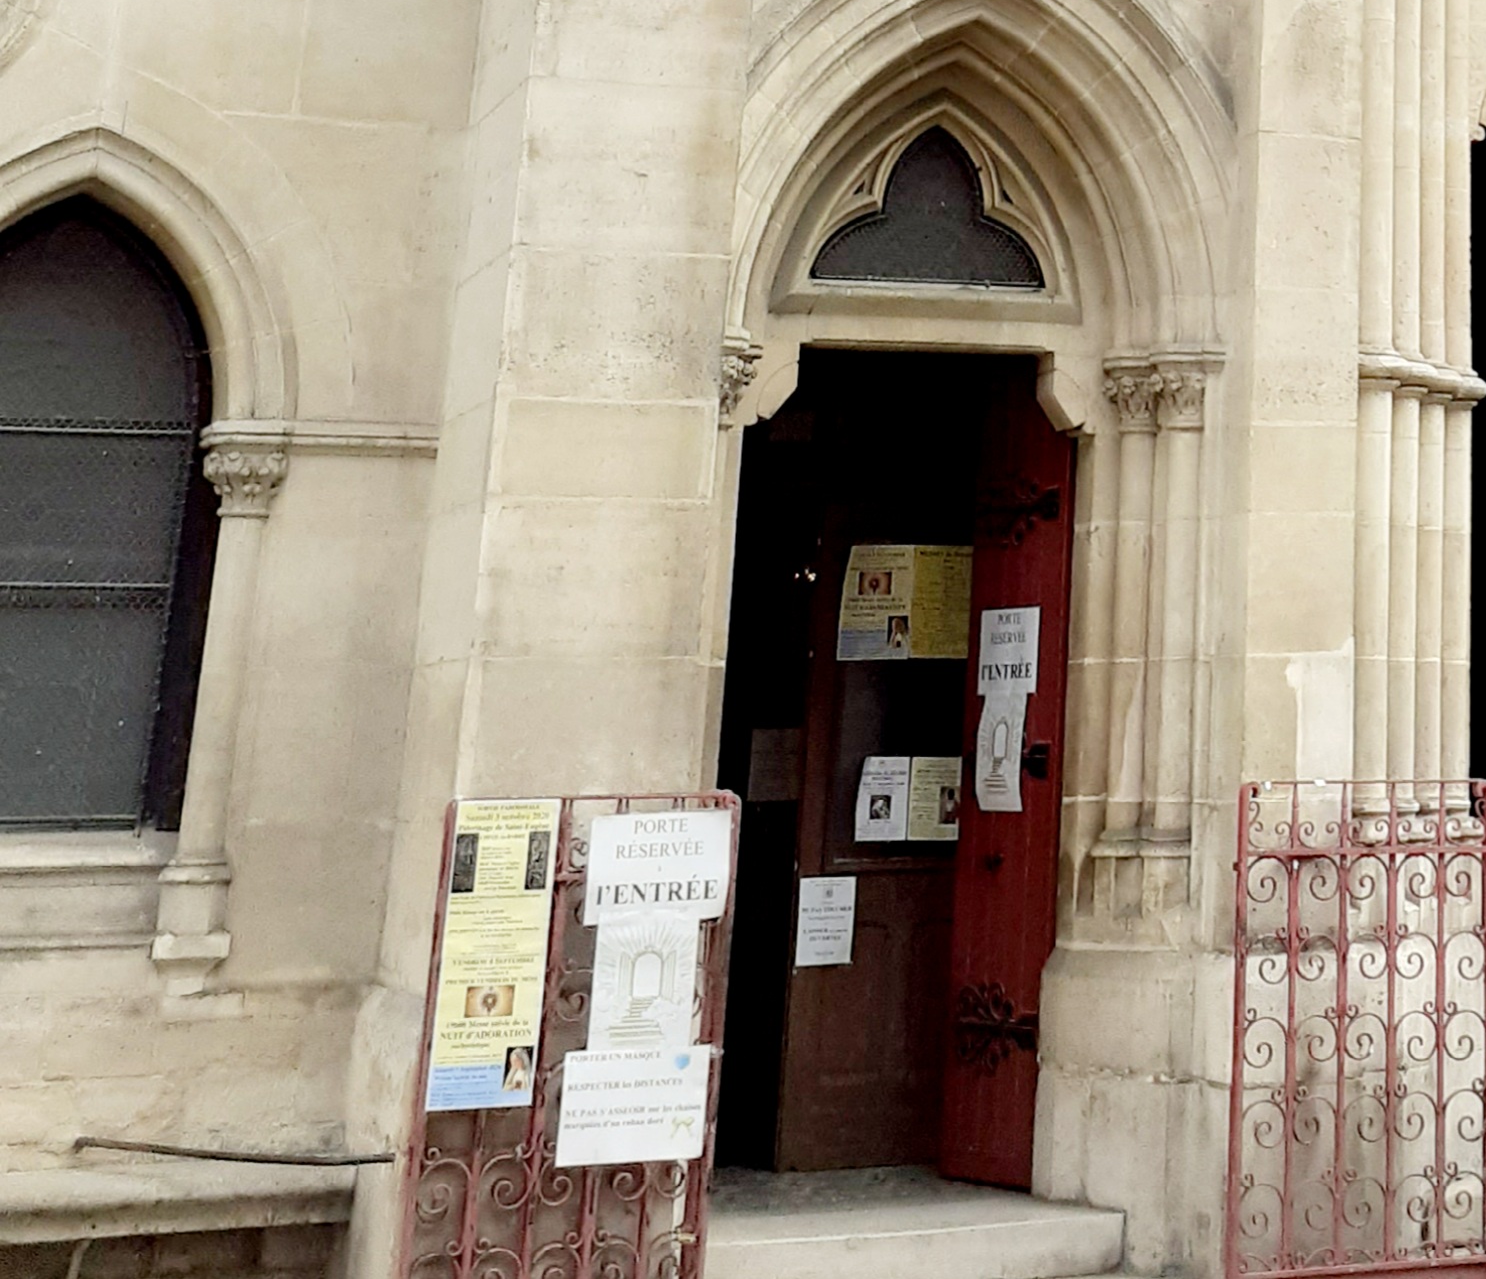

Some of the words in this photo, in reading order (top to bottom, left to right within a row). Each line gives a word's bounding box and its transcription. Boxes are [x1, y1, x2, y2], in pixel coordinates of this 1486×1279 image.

[633, 818, 689, 835] PORTE
[615, 837, 705, 860] RÉSERVÉE
[596, 874, 719, 906] l'ENTRÉE
